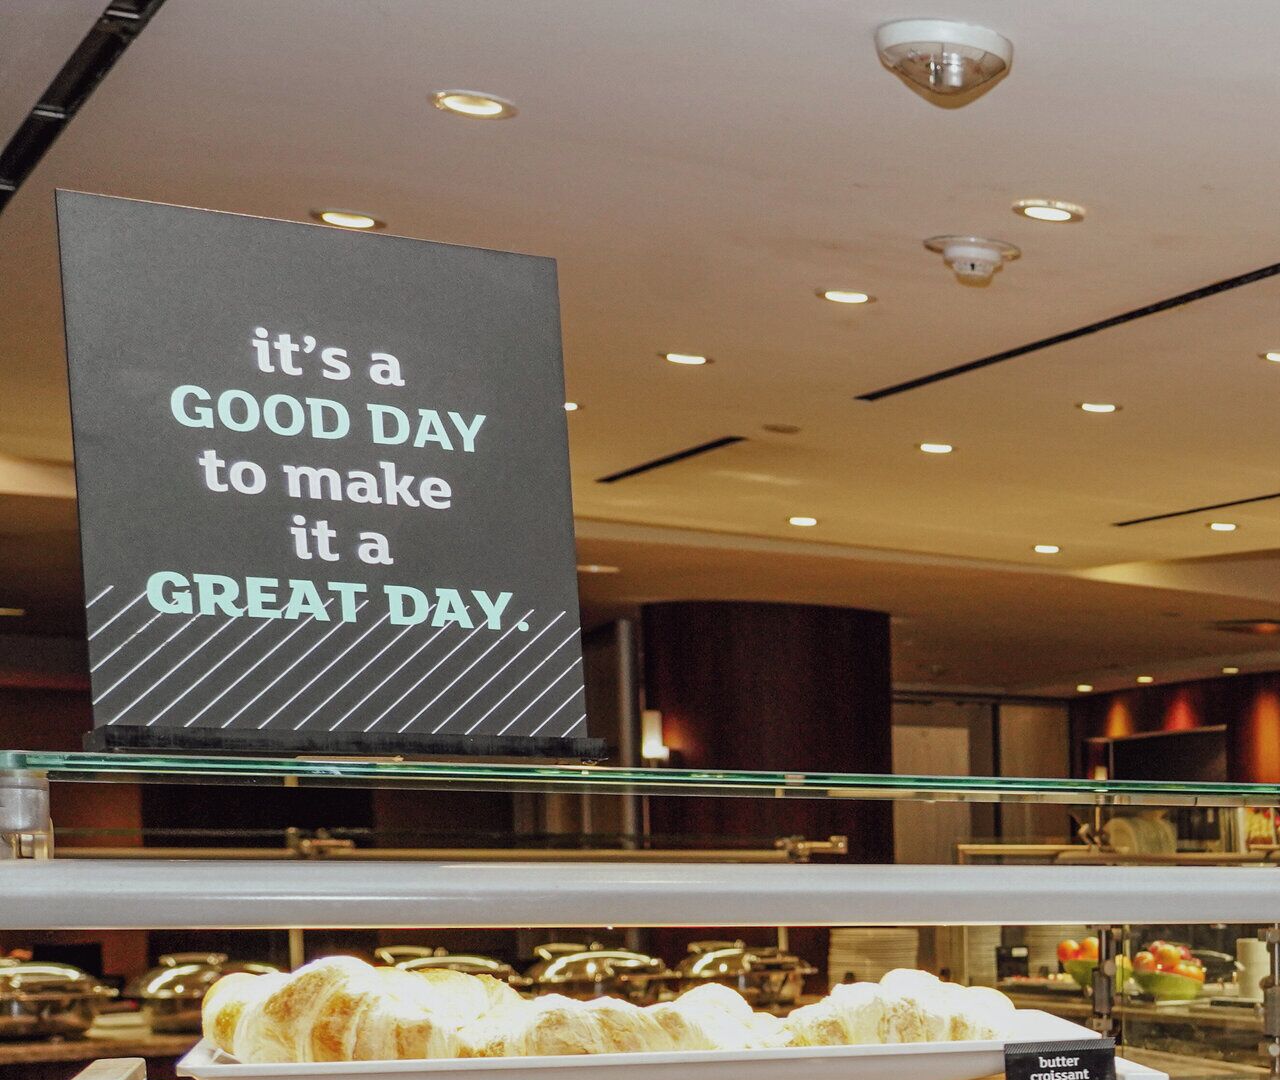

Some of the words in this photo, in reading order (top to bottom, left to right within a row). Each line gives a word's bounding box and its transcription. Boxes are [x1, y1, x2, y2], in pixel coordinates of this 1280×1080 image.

[253, 327, 352, 382] it’s
[370, 353, 406, 387] a
[171, 385, 351, 441] GOOD
[368, 404, 487, 453] DAY
[199, 450, 267, 495] to
[284, 462, 452, 510] make
[291, 516, 340, 563] it
[358, 532, 394, 566] a
[146, 570, 367, 624] GREAT
[384, 584, 530, 633] DAY.
[1038, 1056, 1080, 1068] butter
